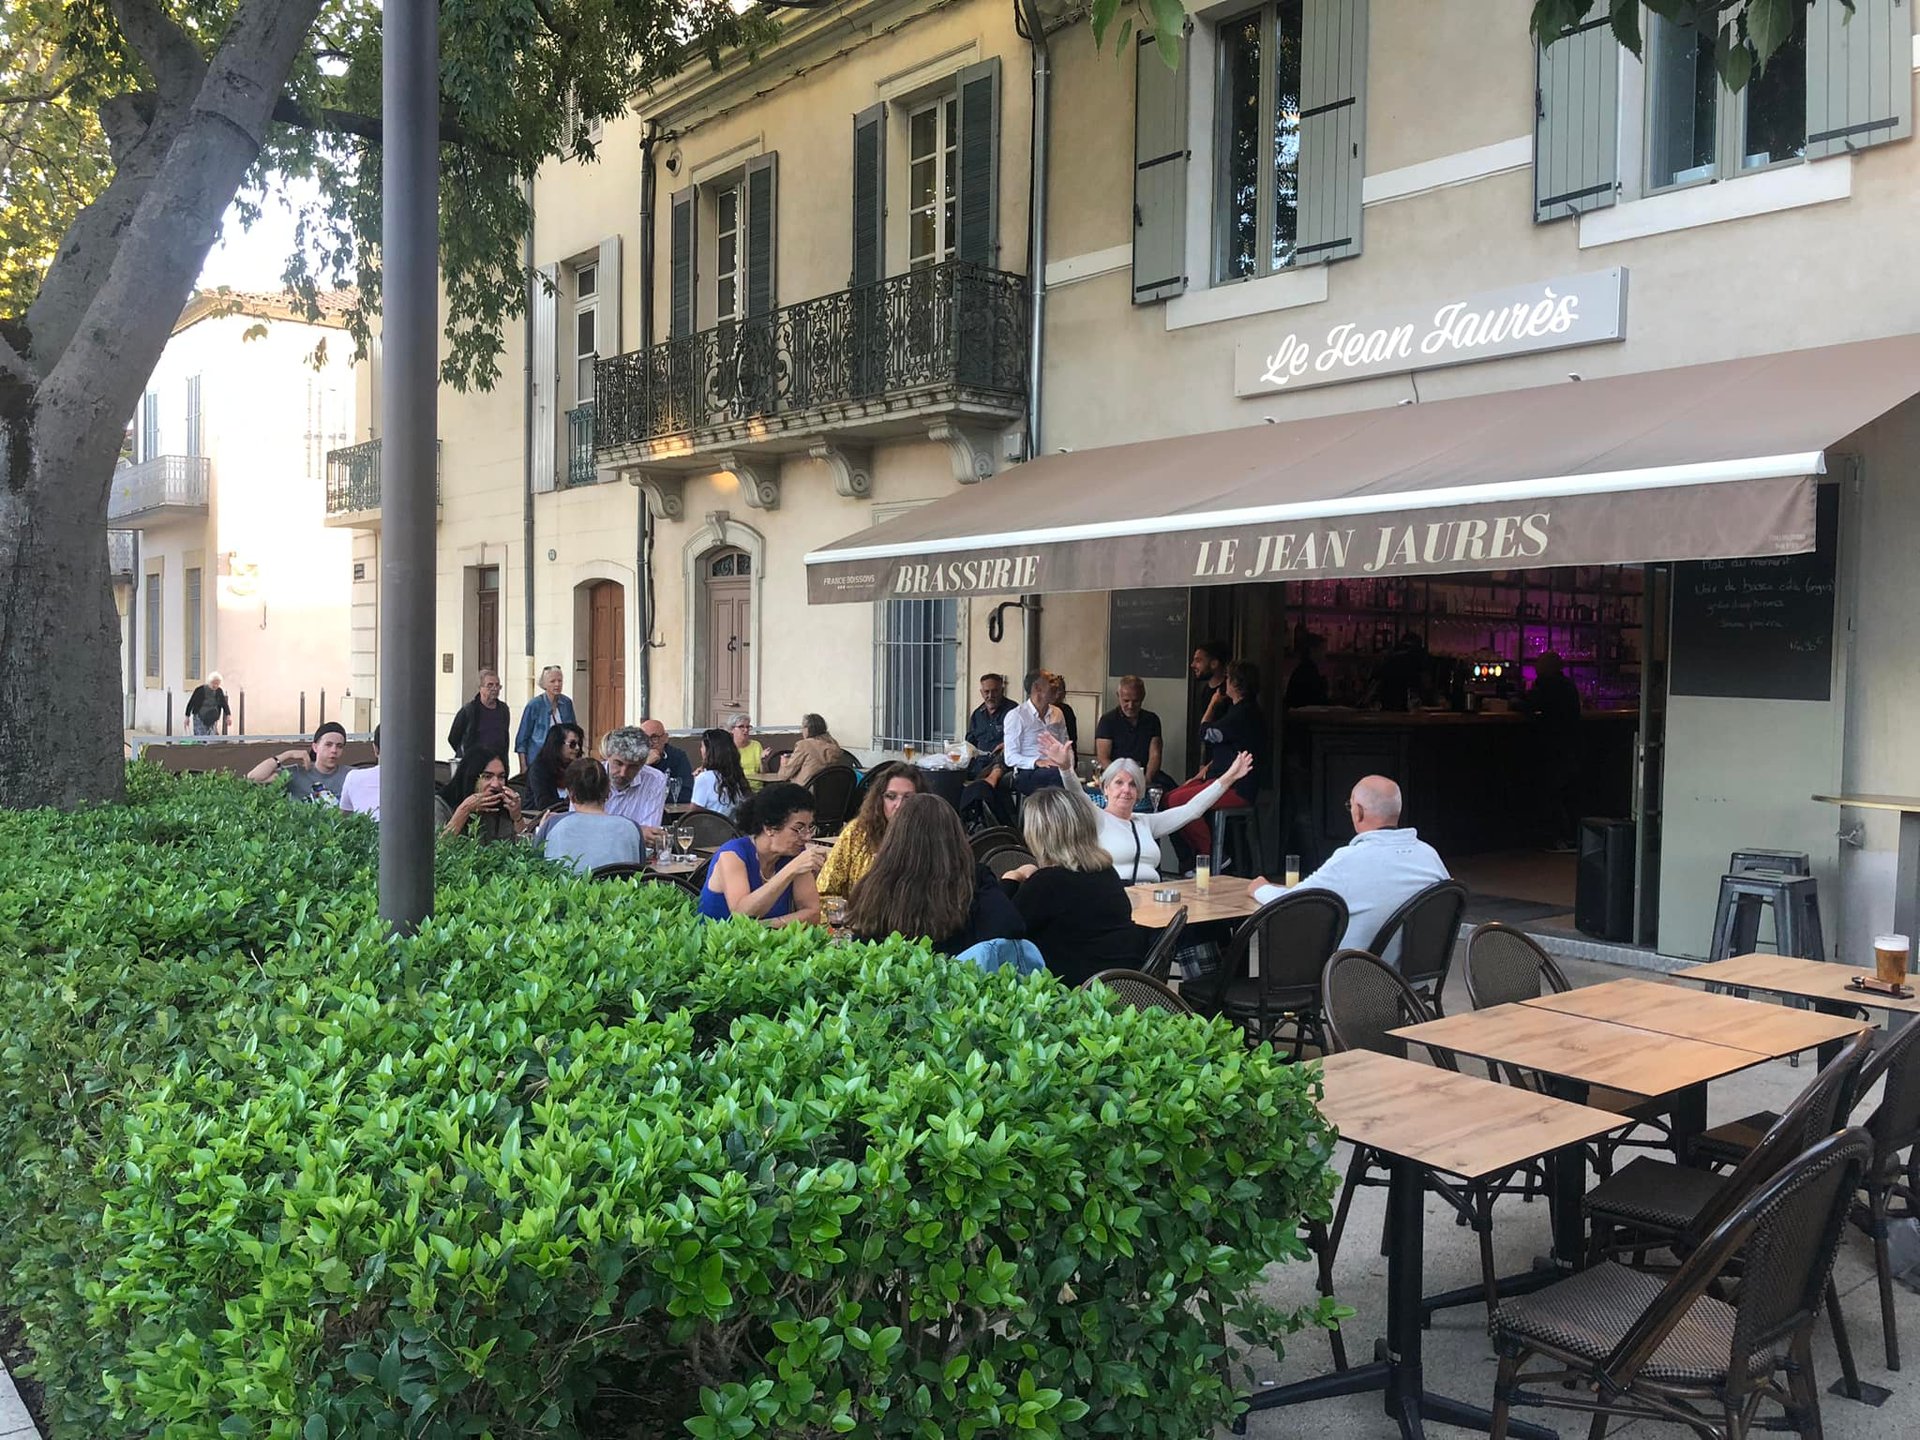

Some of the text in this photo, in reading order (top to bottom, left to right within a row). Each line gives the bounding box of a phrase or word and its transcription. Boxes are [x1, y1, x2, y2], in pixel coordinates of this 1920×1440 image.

[1260, 286, 1579, 386] Le Jean Jaurès
[894, 555, 1041, 593] BRASSERIE
[1192, 512, 1552, 578] LE JEAN JAURES
